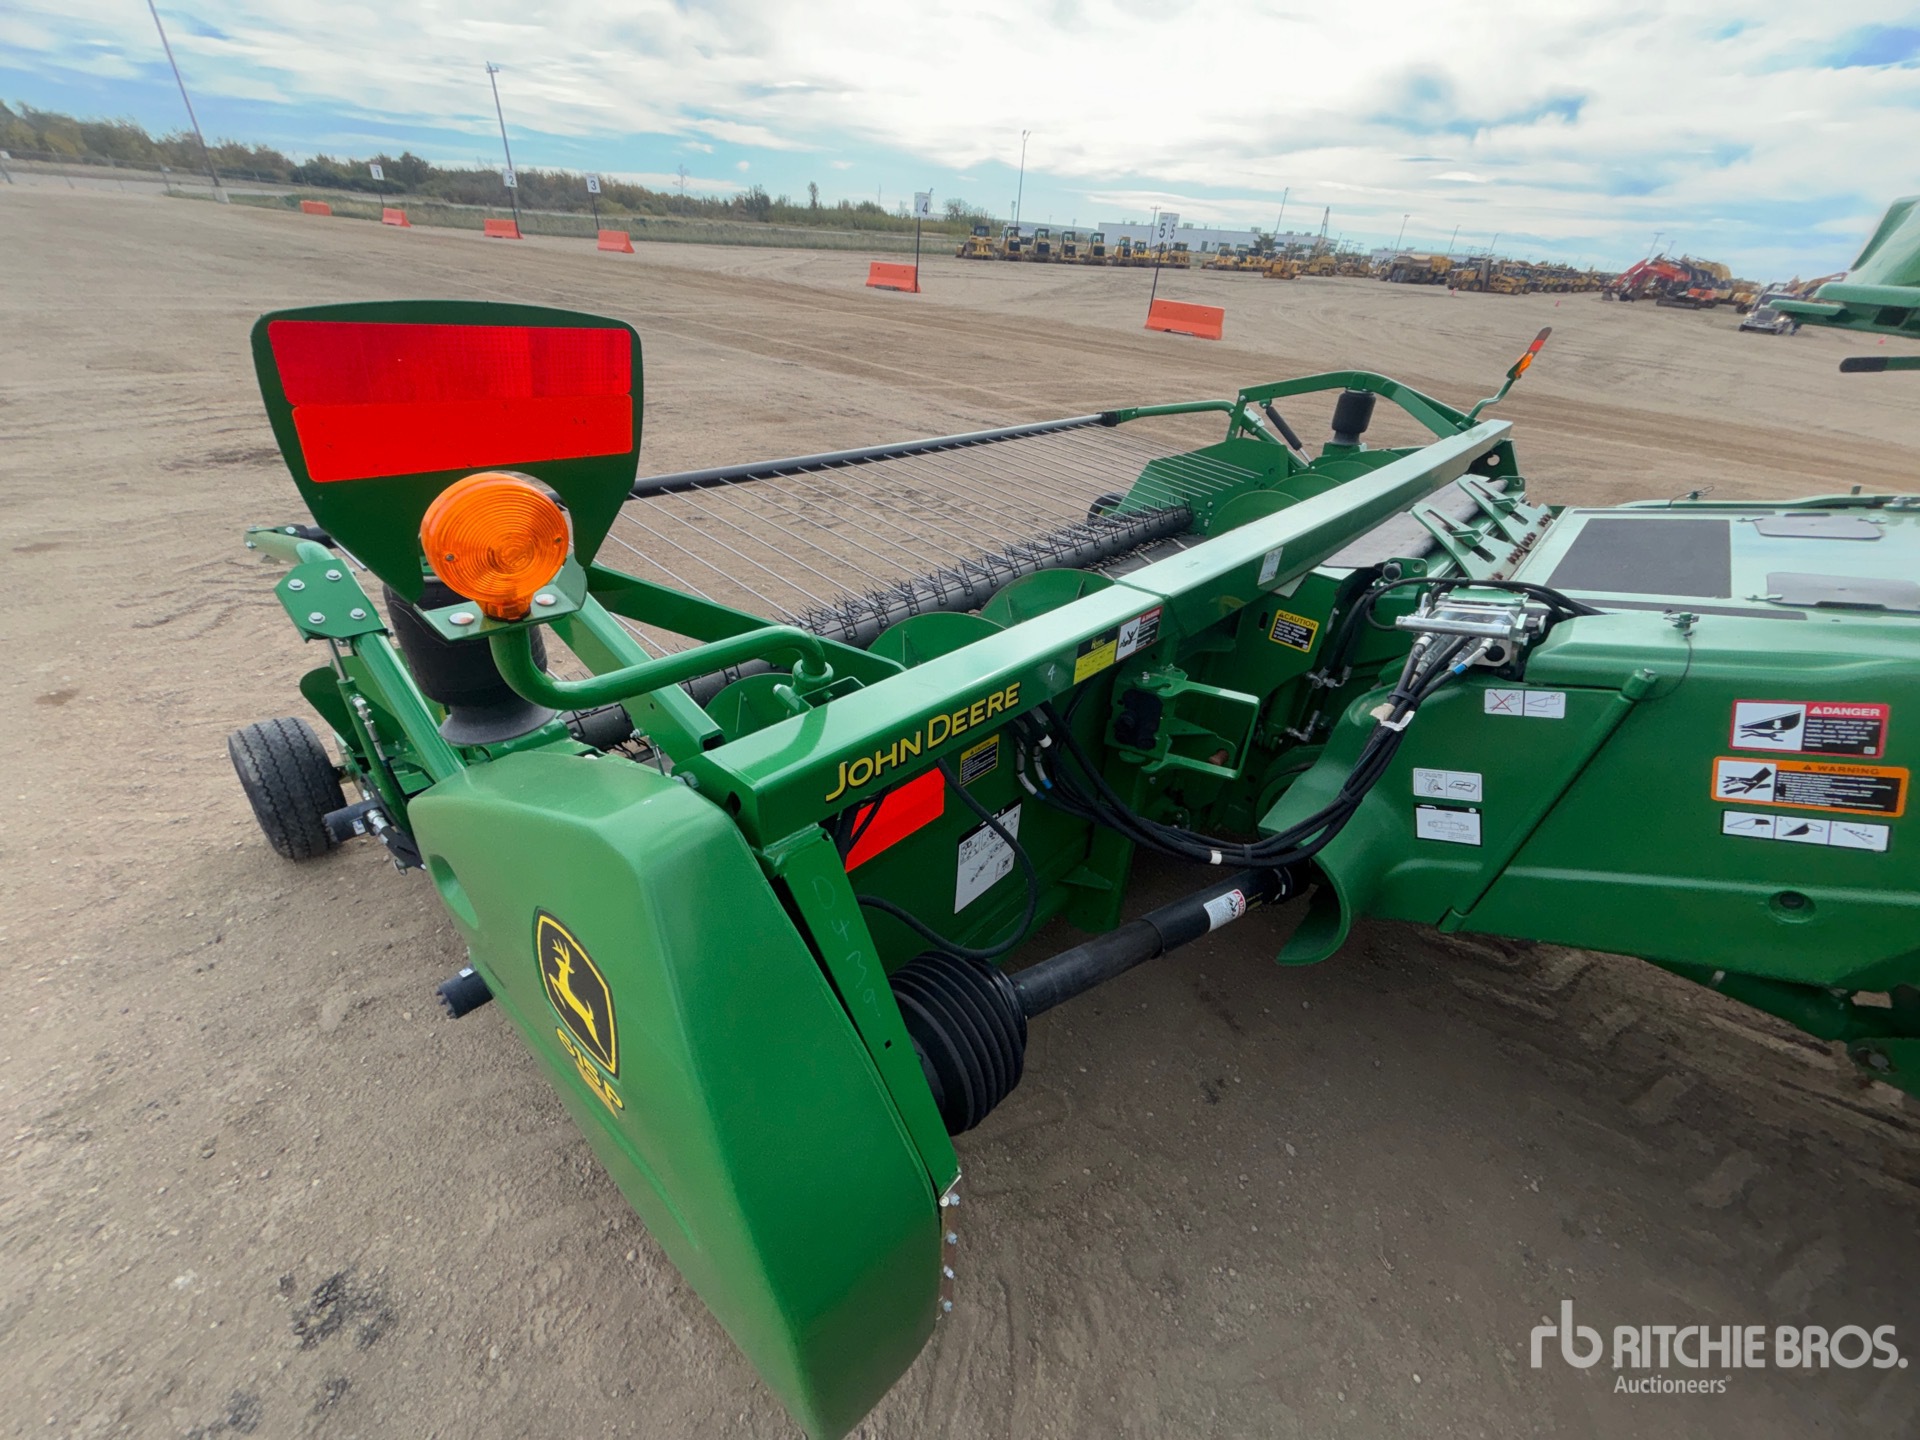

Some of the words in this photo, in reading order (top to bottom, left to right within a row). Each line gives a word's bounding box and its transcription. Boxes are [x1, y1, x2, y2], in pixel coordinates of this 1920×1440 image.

[590, 179, 598, 191] 3
[921, 201, 929, 216] 4
[1158, 222, 1167, 239] 5
[1169, 223, 1176, 240] 5
[1284, 613, 1317, 628] CAUTION
[1822, 706, 1881, 717] DANGER
[825, 730, 922, 802] JOHN
[927, 681, 1021, 750] DEERE
[1817, 765, 1880, 776] WARNING
